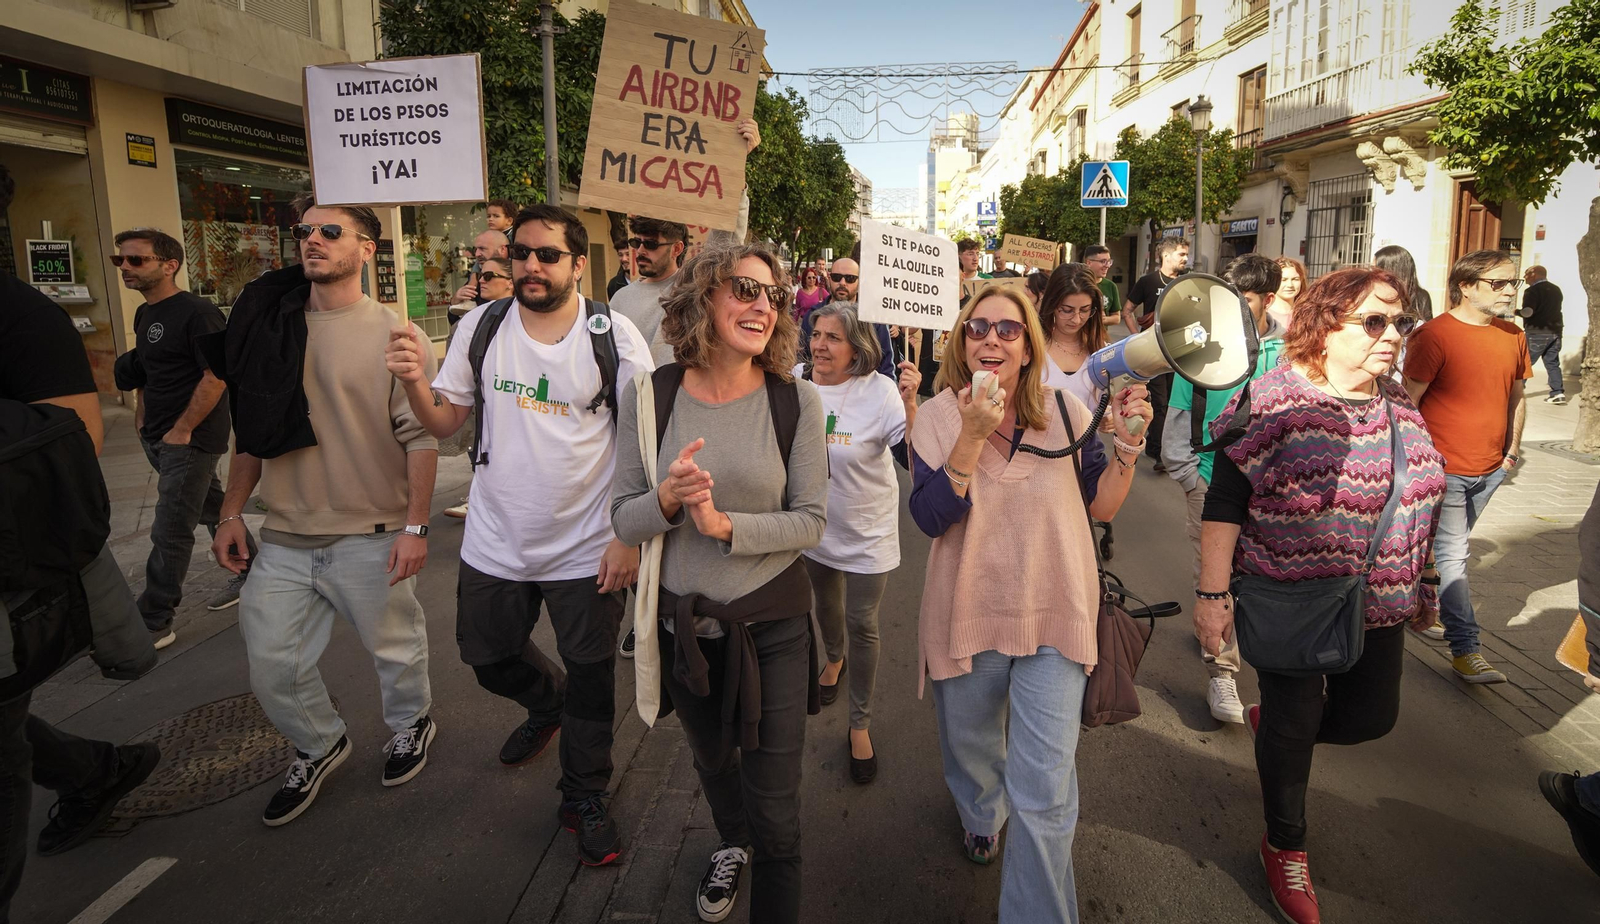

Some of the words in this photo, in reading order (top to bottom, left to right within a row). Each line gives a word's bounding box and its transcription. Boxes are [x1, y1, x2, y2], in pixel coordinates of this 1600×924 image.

[653, 32, 718, 76] TU
[52, 78, 70, 90] CITAS
[337, 73, 438, 97] LIMITACIÓN
[618, 64, 742, 122] AIRBNB
[334, 108, 355, 122] DE
[360, 106, 392, 121] LOS
[396, 103, 449, 119] PISOS
[276, 133, 305, 147] LENTES
[339, 128, 442, 148] TURÍSTICOS
[640, 112, 709, 155] ERA
[371, 159, 418, 184] ¡YA!
[600, 148, 637, 184] MI
[640, 155, 723, 199] CASA
[48, 243, 68, 251] FRIDAY
[881, 234, 893, 247] SI
[895, 237, 907, 250] TE
[910, 241, 940, 257] PAGO
[1008, 237, 1022, 246] ALL
[1007, 248, 1020, 257] ARE
[1021, 249, 1055, 262] BASTARDS
[33, 259, 66, 273] -50%
[878, 254, 890, 267] EL
[892, 258, 945, 278] ALQUILER
[883, 276, 899, 289] ME
[901, 280, 939, 296] QUEDO
[882, 297, 901, 310] SIN
[904, 301, 943, 316] COMER
[516, 395, 570, 417] RESISTE
